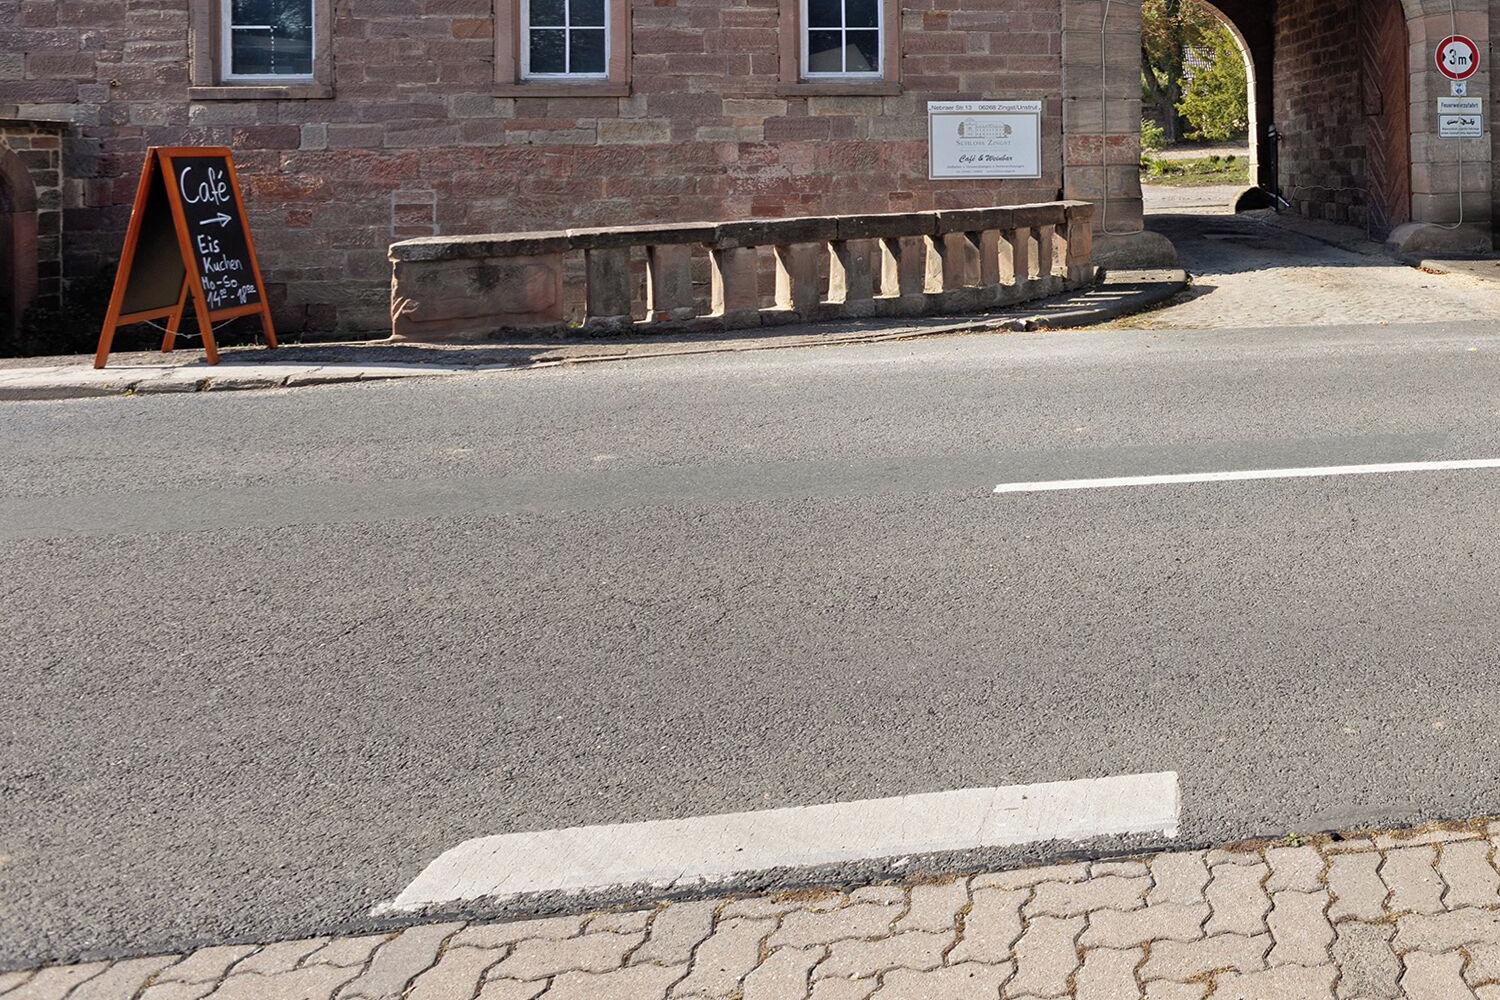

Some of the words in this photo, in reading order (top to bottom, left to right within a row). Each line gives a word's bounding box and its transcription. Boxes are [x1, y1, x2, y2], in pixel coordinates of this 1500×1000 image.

[959, 154, 976, 164] Café
[977, 154, 984, 162] &
[984, 154, 1013, 162] Weinbar
[180, 166, 231, 206] Café
[197, 234, 220, 254] Eis
[203, 254, 243, 274] Kuchen
